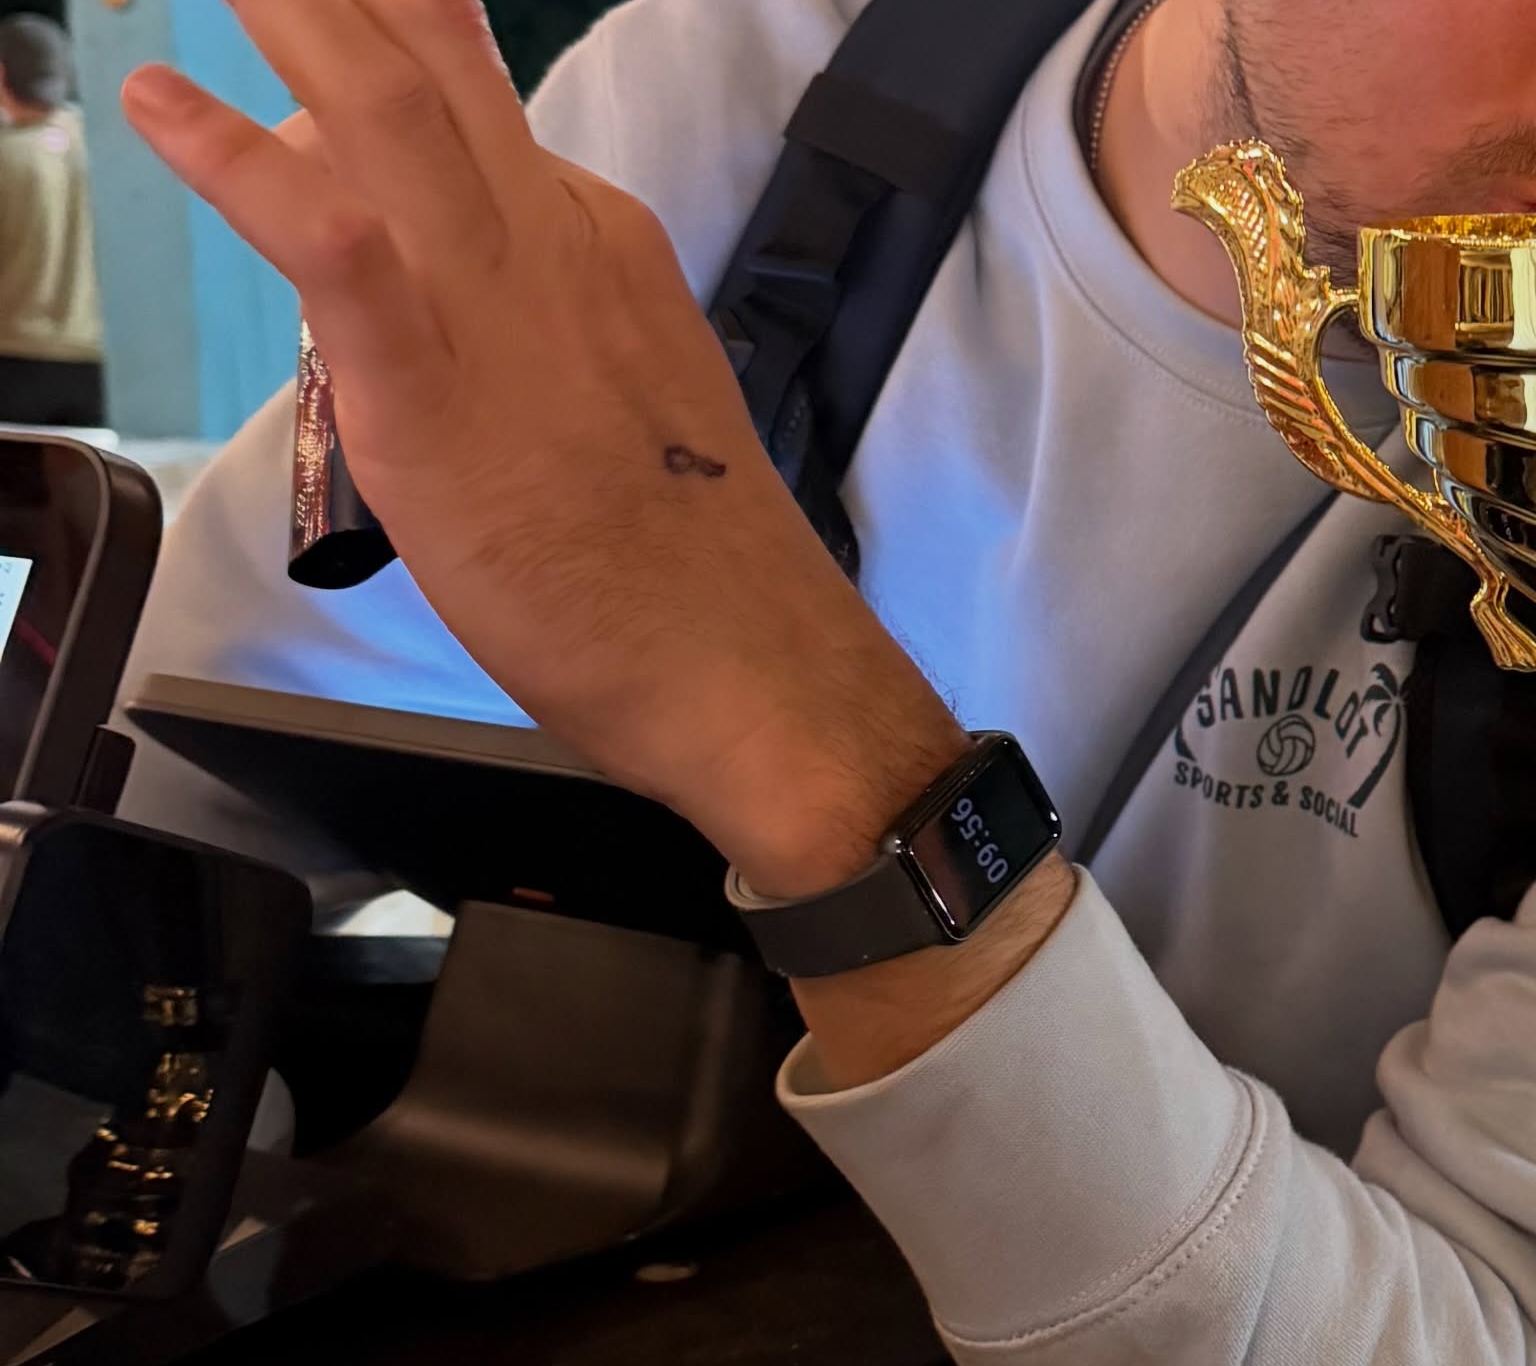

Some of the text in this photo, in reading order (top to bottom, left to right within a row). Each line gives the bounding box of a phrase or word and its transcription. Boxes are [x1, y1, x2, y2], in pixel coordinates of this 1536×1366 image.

[1196, 666, 1369, 758] SANDLOT
[951, 798, 1009, 884] 09:56
[1174, 762, 1359, 837] SPORTS & SOCIAL
